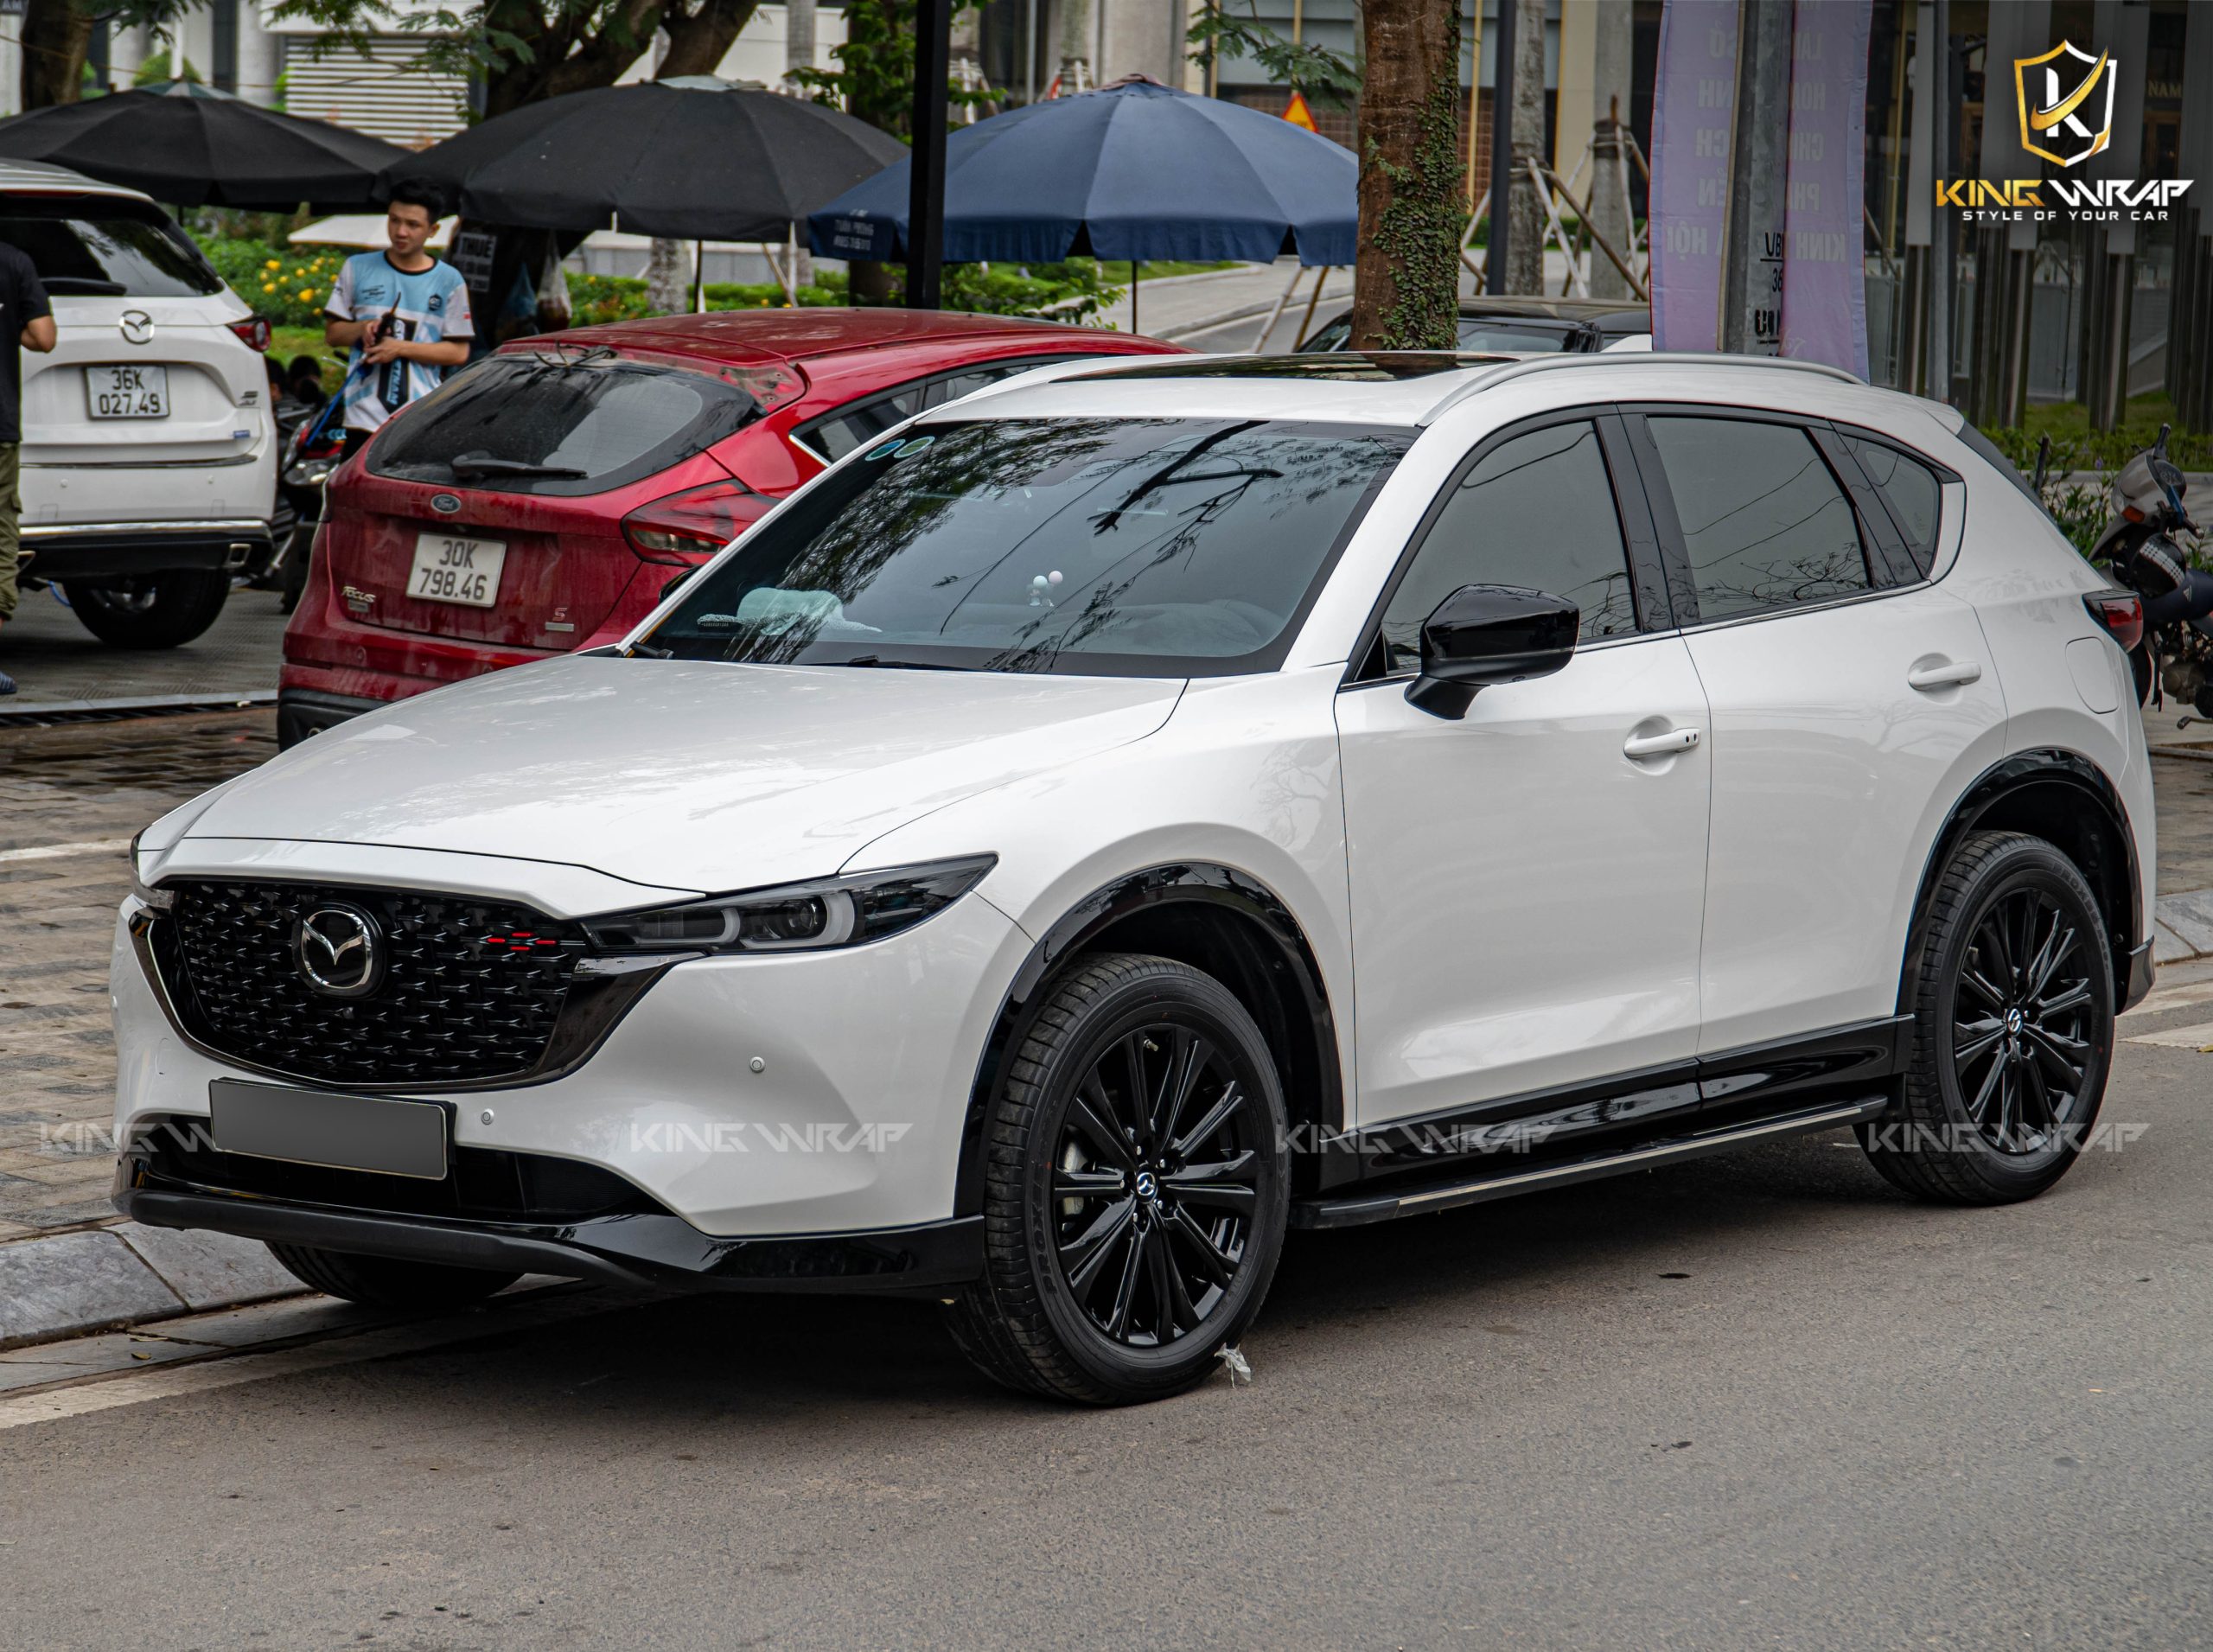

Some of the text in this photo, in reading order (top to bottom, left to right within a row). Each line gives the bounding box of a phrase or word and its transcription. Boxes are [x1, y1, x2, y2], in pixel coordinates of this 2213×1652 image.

[112, 369, 144, 390] 36K
[99, 393, 161, 414] 027.49
[439, 540, 478, 568] 30K
[418, 568, 488, 600] 798.46
